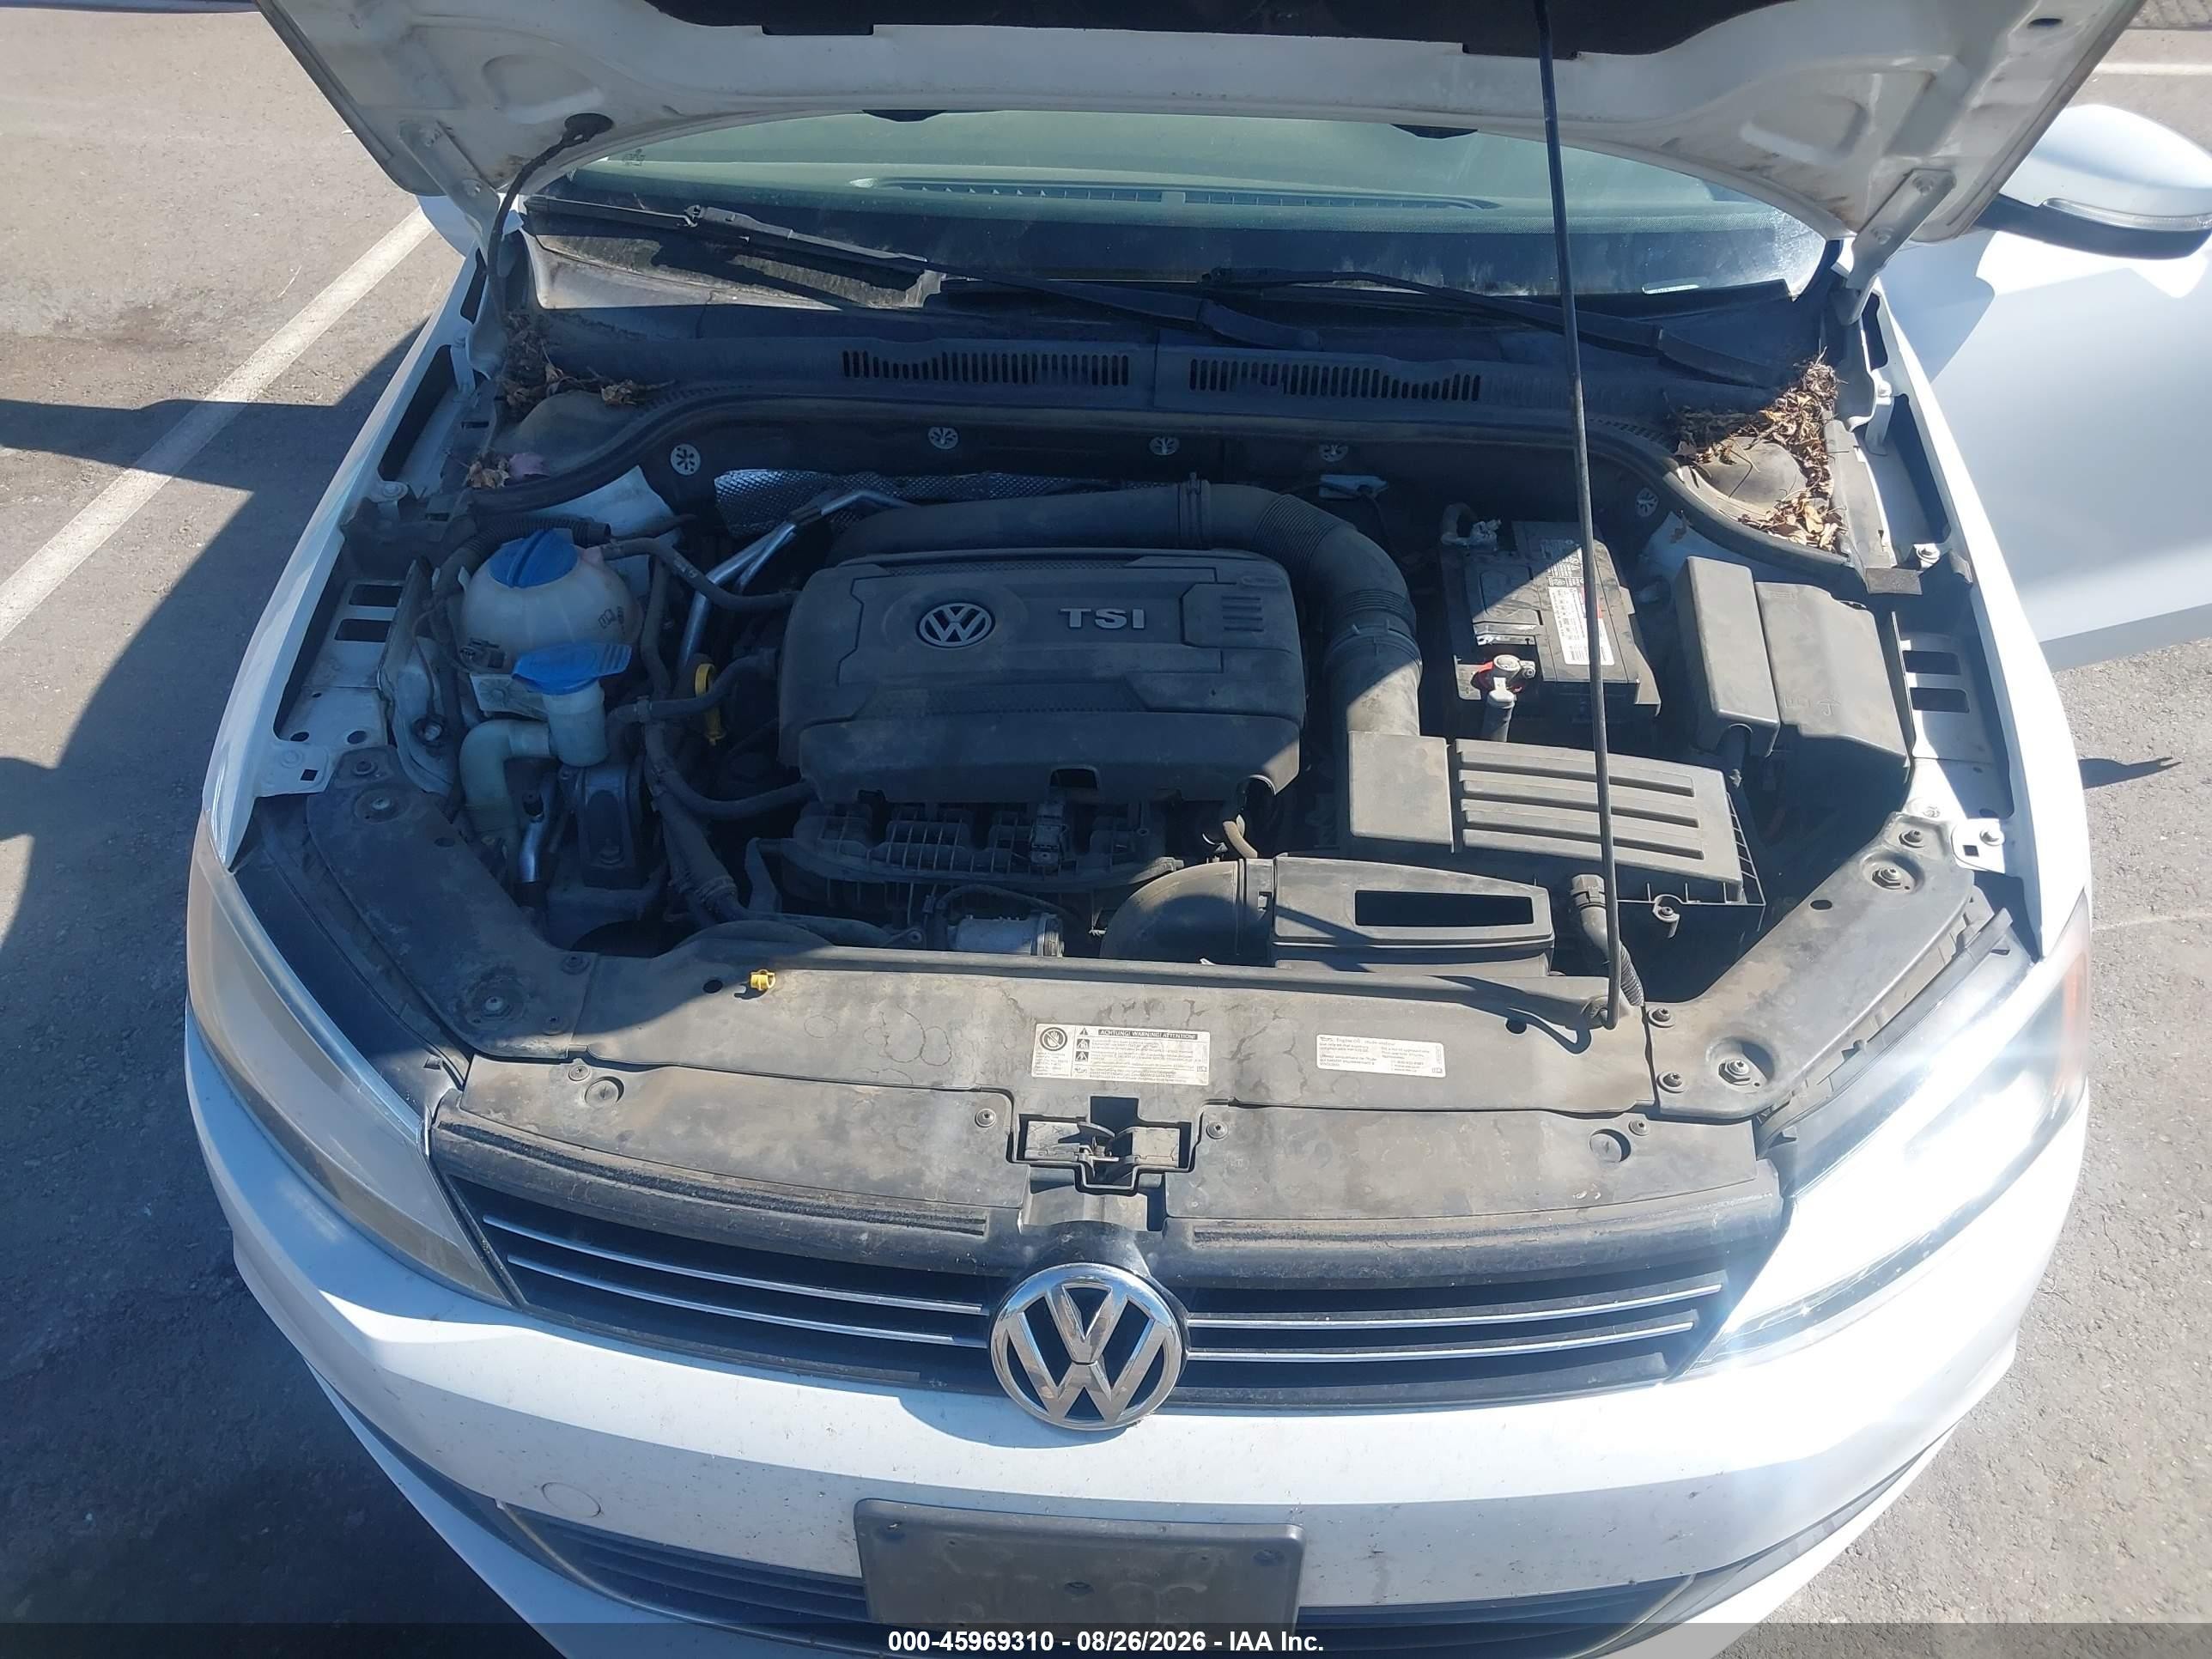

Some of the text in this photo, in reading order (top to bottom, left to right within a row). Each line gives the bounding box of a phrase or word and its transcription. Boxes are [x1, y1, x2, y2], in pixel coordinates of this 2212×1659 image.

[919, 603, 993, 647] VW
[1060, 608, 1145, 629] TSI
[991, 1262, 1182, 1431] VW
